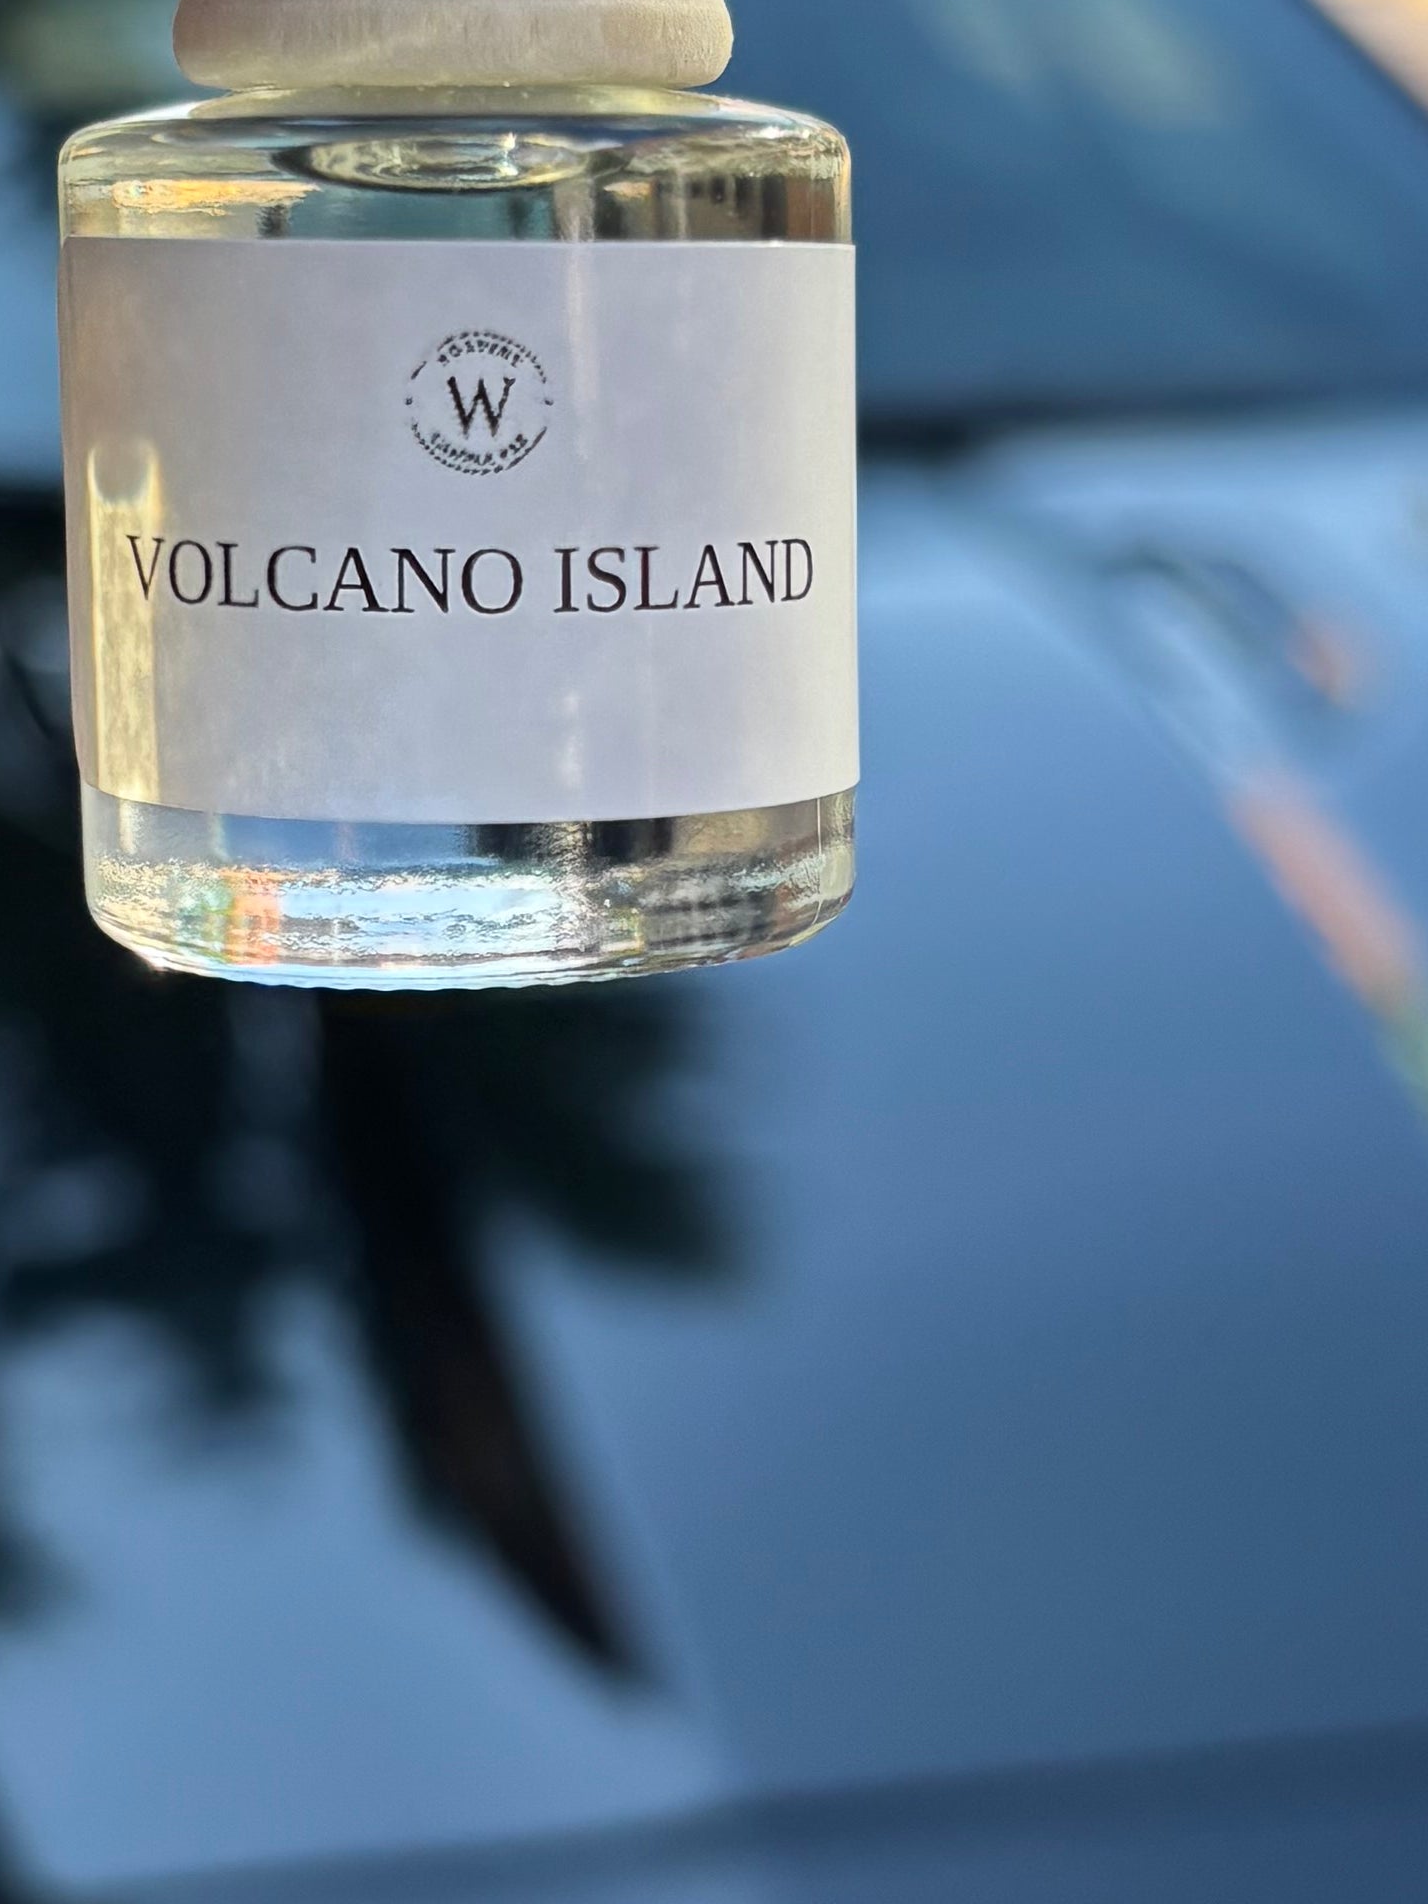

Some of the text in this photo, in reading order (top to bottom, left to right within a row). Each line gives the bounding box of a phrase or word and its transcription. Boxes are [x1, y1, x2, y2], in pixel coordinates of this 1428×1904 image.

[446, 376, 516, 439] W
[125, 534, 814, 615] VOLCANO ISLAND
